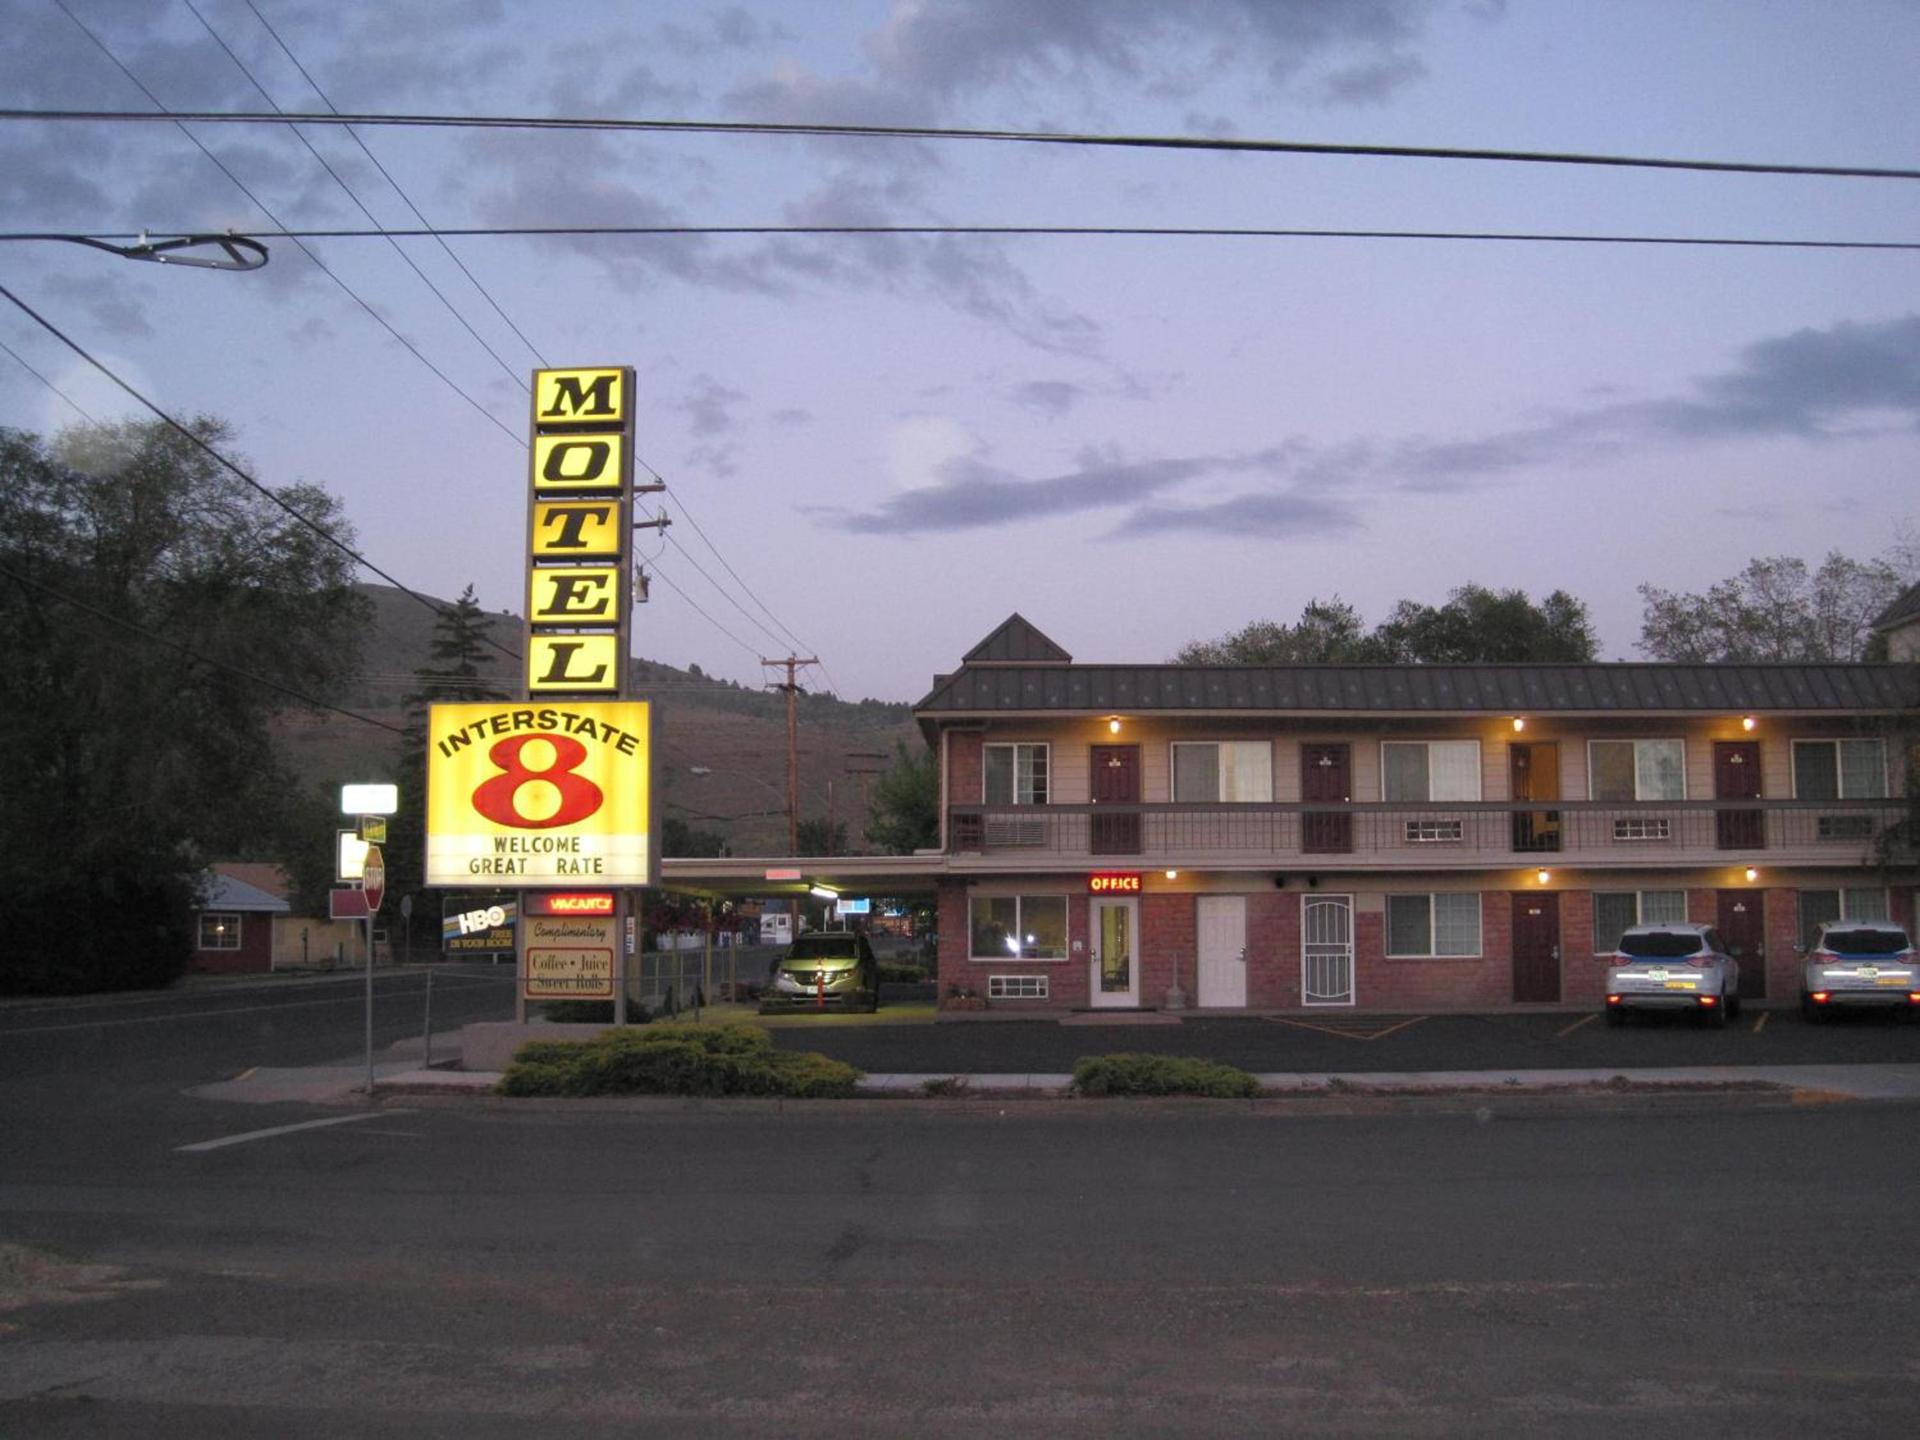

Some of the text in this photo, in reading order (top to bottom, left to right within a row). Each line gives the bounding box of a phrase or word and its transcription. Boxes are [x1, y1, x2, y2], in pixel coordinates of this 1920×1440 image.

[537, 375, 618, 683] MOTEL
[438, 709, 640, 759] INTERSTATE
[472, 733, 604, 829] 8
[494, 837, 580, 853] WELCOME
[469, 858, 603, 874] GREAT RATE
[1091, 877, 1139, 890] OFFICE
[550, 898, 612, 910] VACANCY
[458, 906, 505, 934] HBO
[534, 922, 606, 942] Complimentary
[533, 954, 609, 971] Coffee Juice
